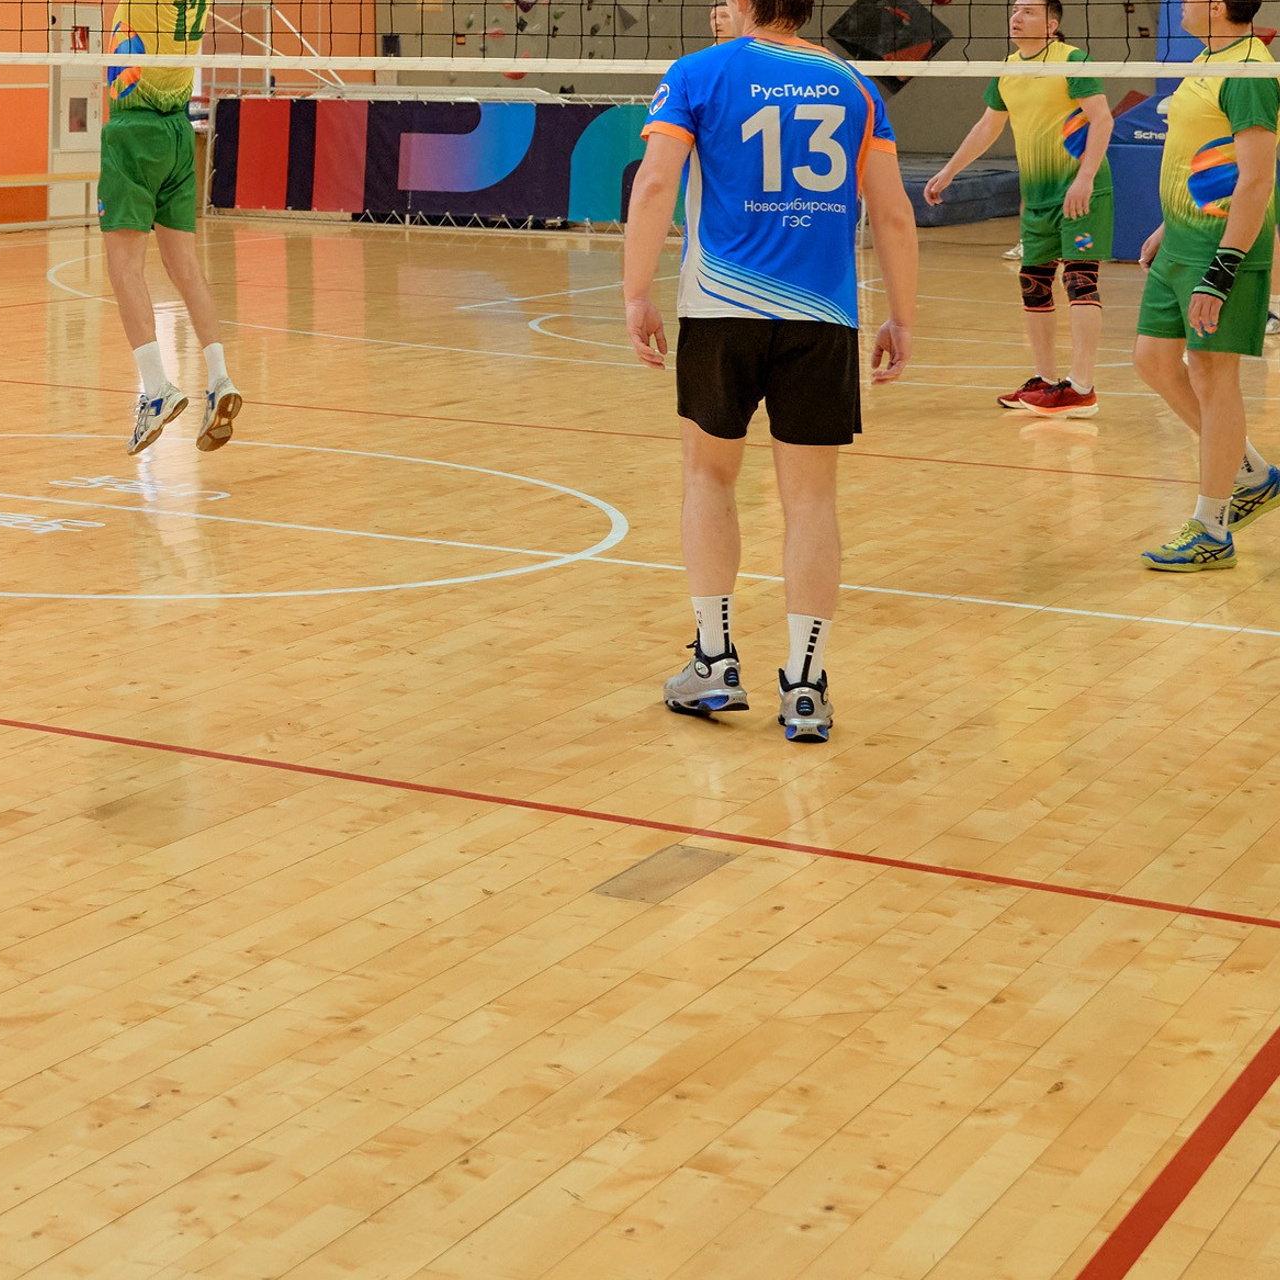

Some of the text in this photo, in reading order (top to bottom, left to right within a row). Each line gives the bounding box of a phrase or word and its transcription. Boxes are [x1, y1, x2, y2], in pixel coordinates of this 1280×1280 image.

[750, 83, 840, 100] РусГидро
[741, 103, 848, 193] 13
[744, 198, 847, 214] Новосибирская
[782, 215, 812, 228] ГЭС
